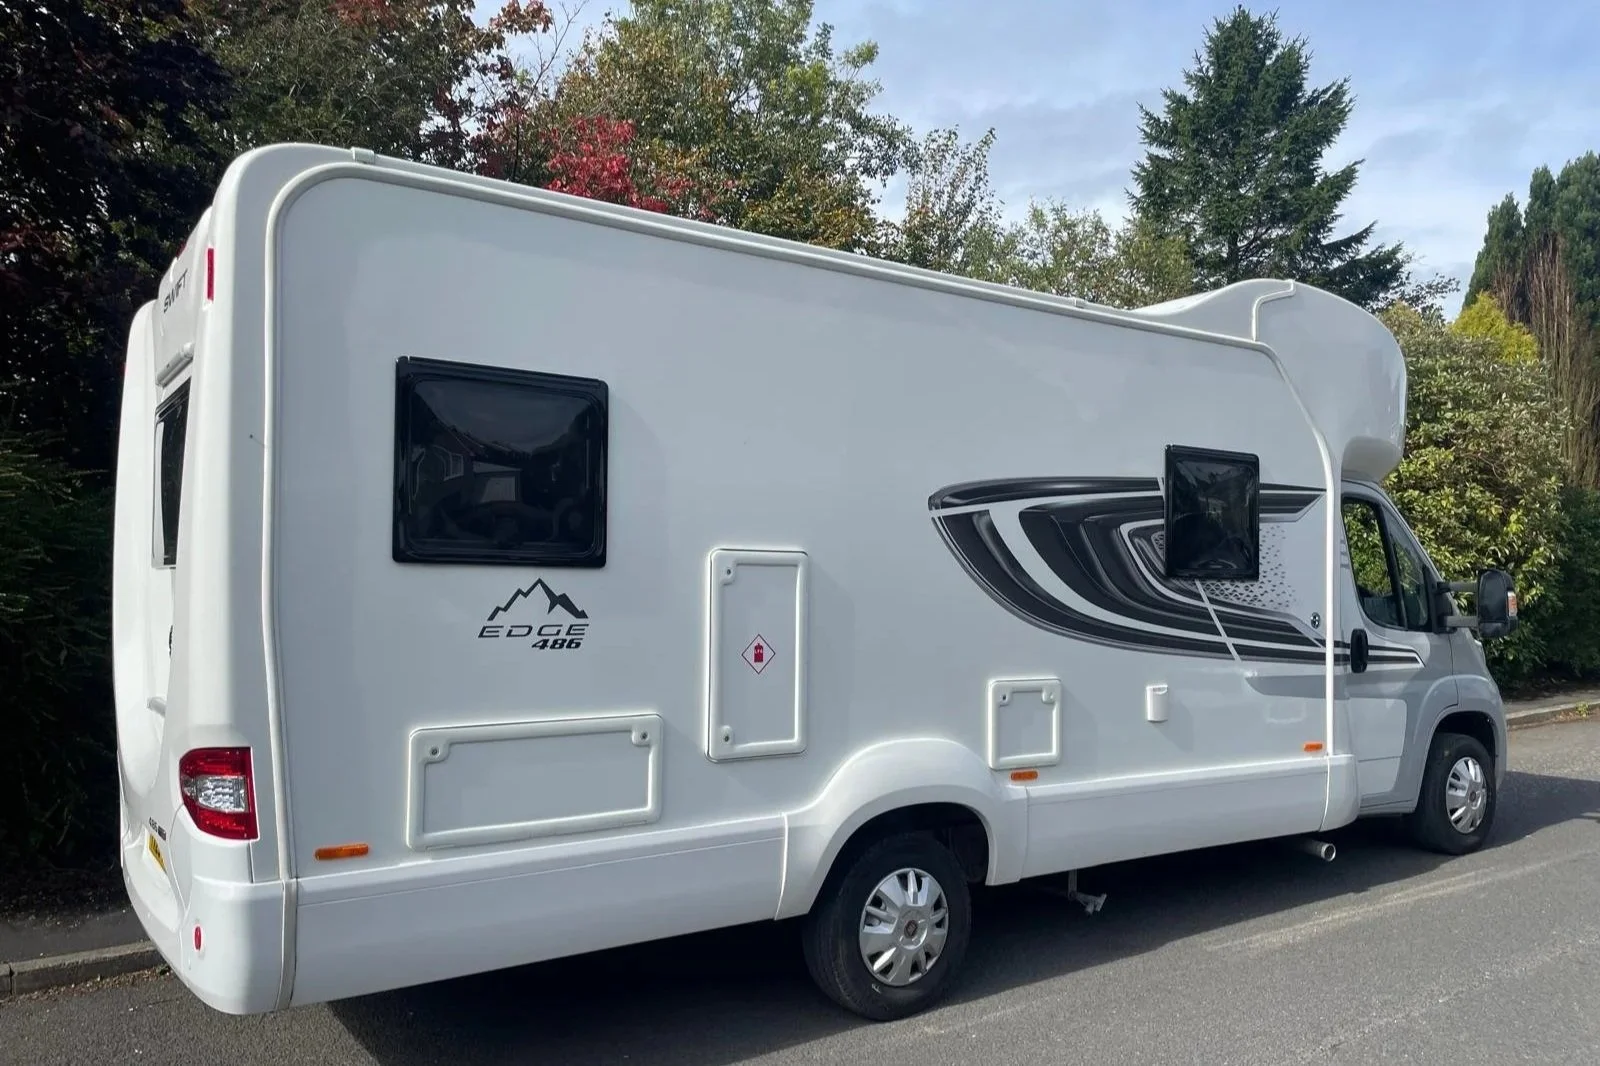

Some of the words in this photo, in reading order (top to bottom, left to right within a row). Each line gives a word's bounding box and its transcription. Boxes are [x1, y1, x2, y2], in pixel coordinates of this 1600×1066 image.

[163, 268, 188, 314] SWIFT
[478, 624, 589, 638] EDGE
[532, 638, 583, 650] 486
